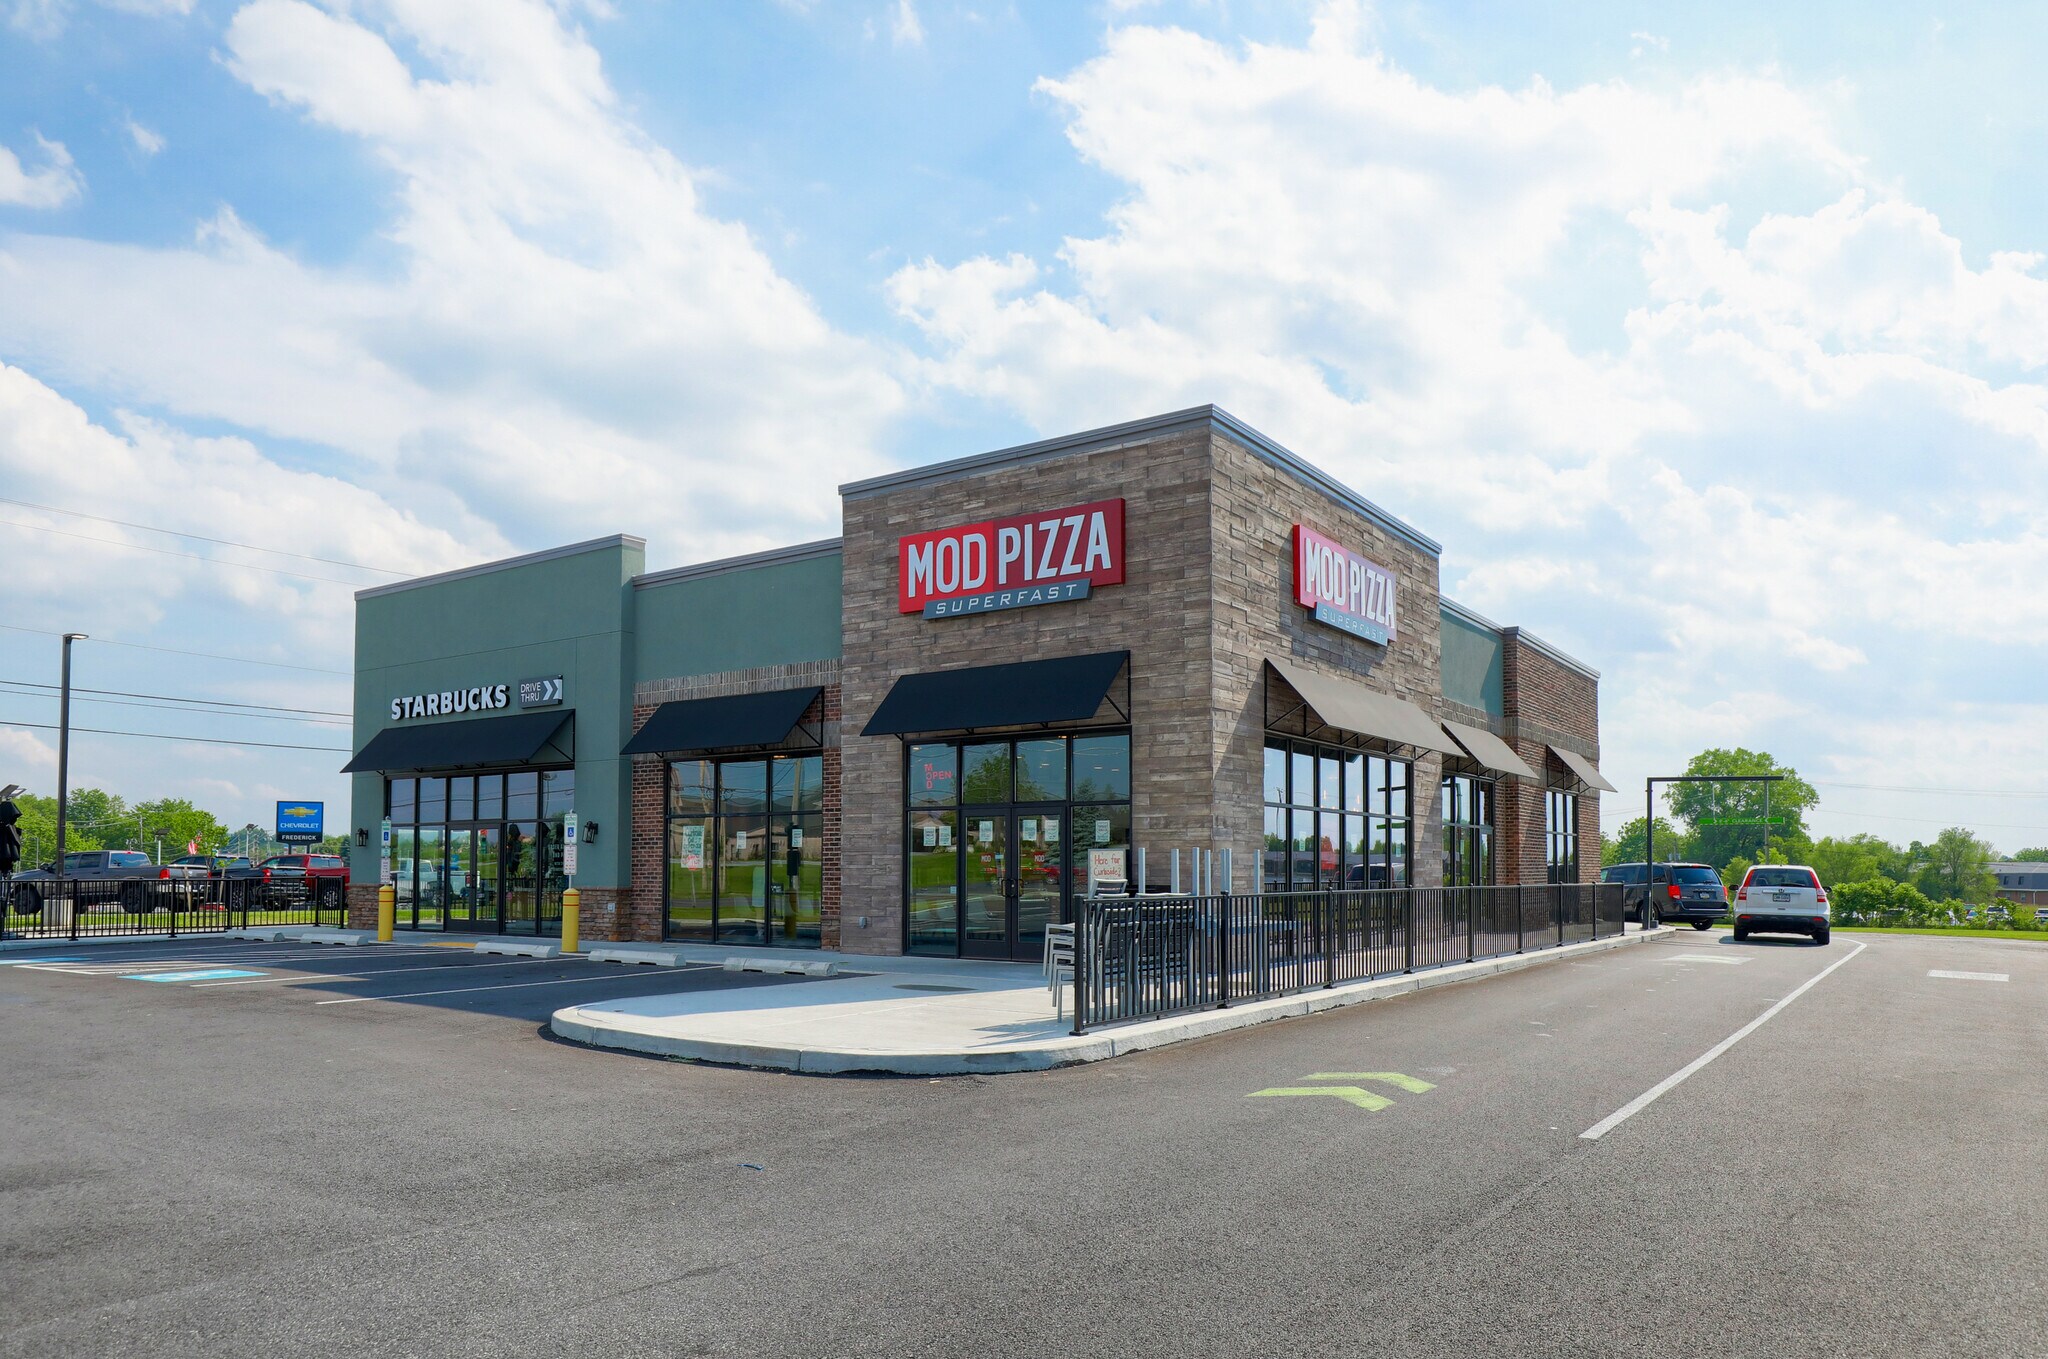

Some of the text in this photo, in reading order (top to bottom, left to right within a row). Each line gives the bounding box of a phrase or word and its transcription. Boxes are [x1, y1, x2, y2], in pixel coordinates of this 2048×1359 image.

[907, 510, 1112, 598] MOD PIZZA
[935, 584, 1077, 614] SUPERFAST
[1305, 537, 1395, 629] MOD PIZZA
[1321, 608, 1384, 641] SUPERFAST
[391, 684, 508, 721] STARBUCKS
[520, 681, 541, 694] DRIVE
[520, 692, 540, 703] THRU
